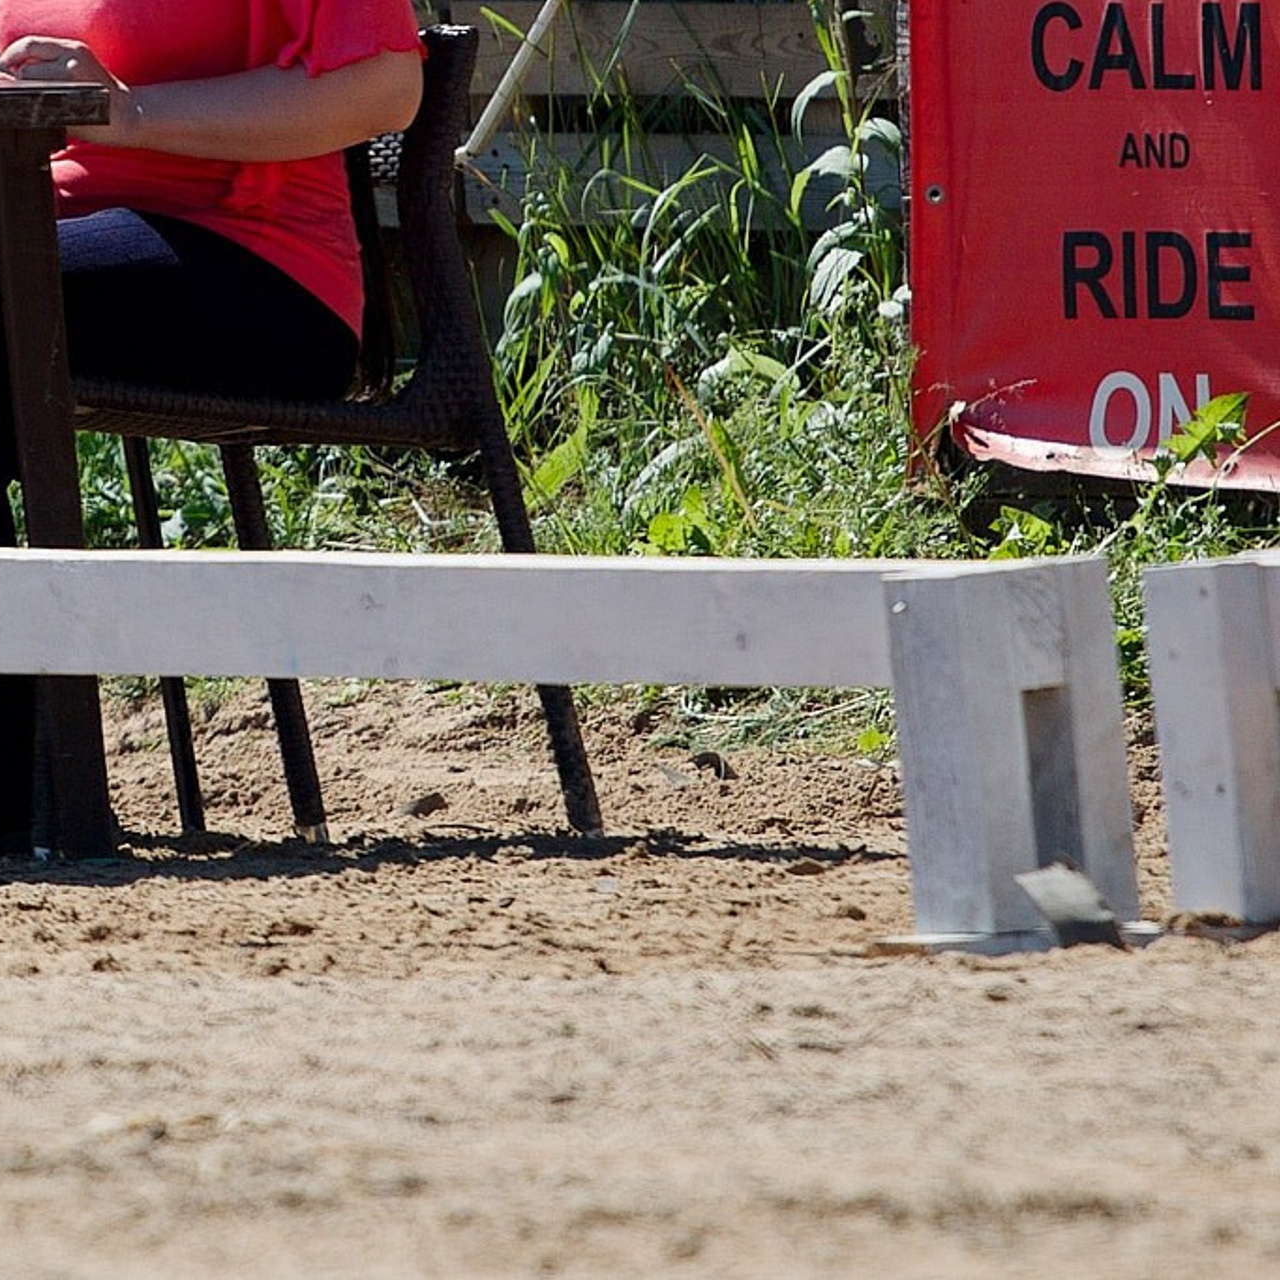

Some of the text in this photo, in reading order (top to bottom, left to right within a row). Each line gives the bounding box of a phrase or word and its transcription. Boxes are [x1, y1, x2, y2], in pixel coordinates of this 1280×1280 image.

[1031, 1, 1262, 92] CALM
[1120, 132, 1190, 168] AND
[1062, 231, 1255, 320] RIDE
[1089, 371, 1211, 458] ON
